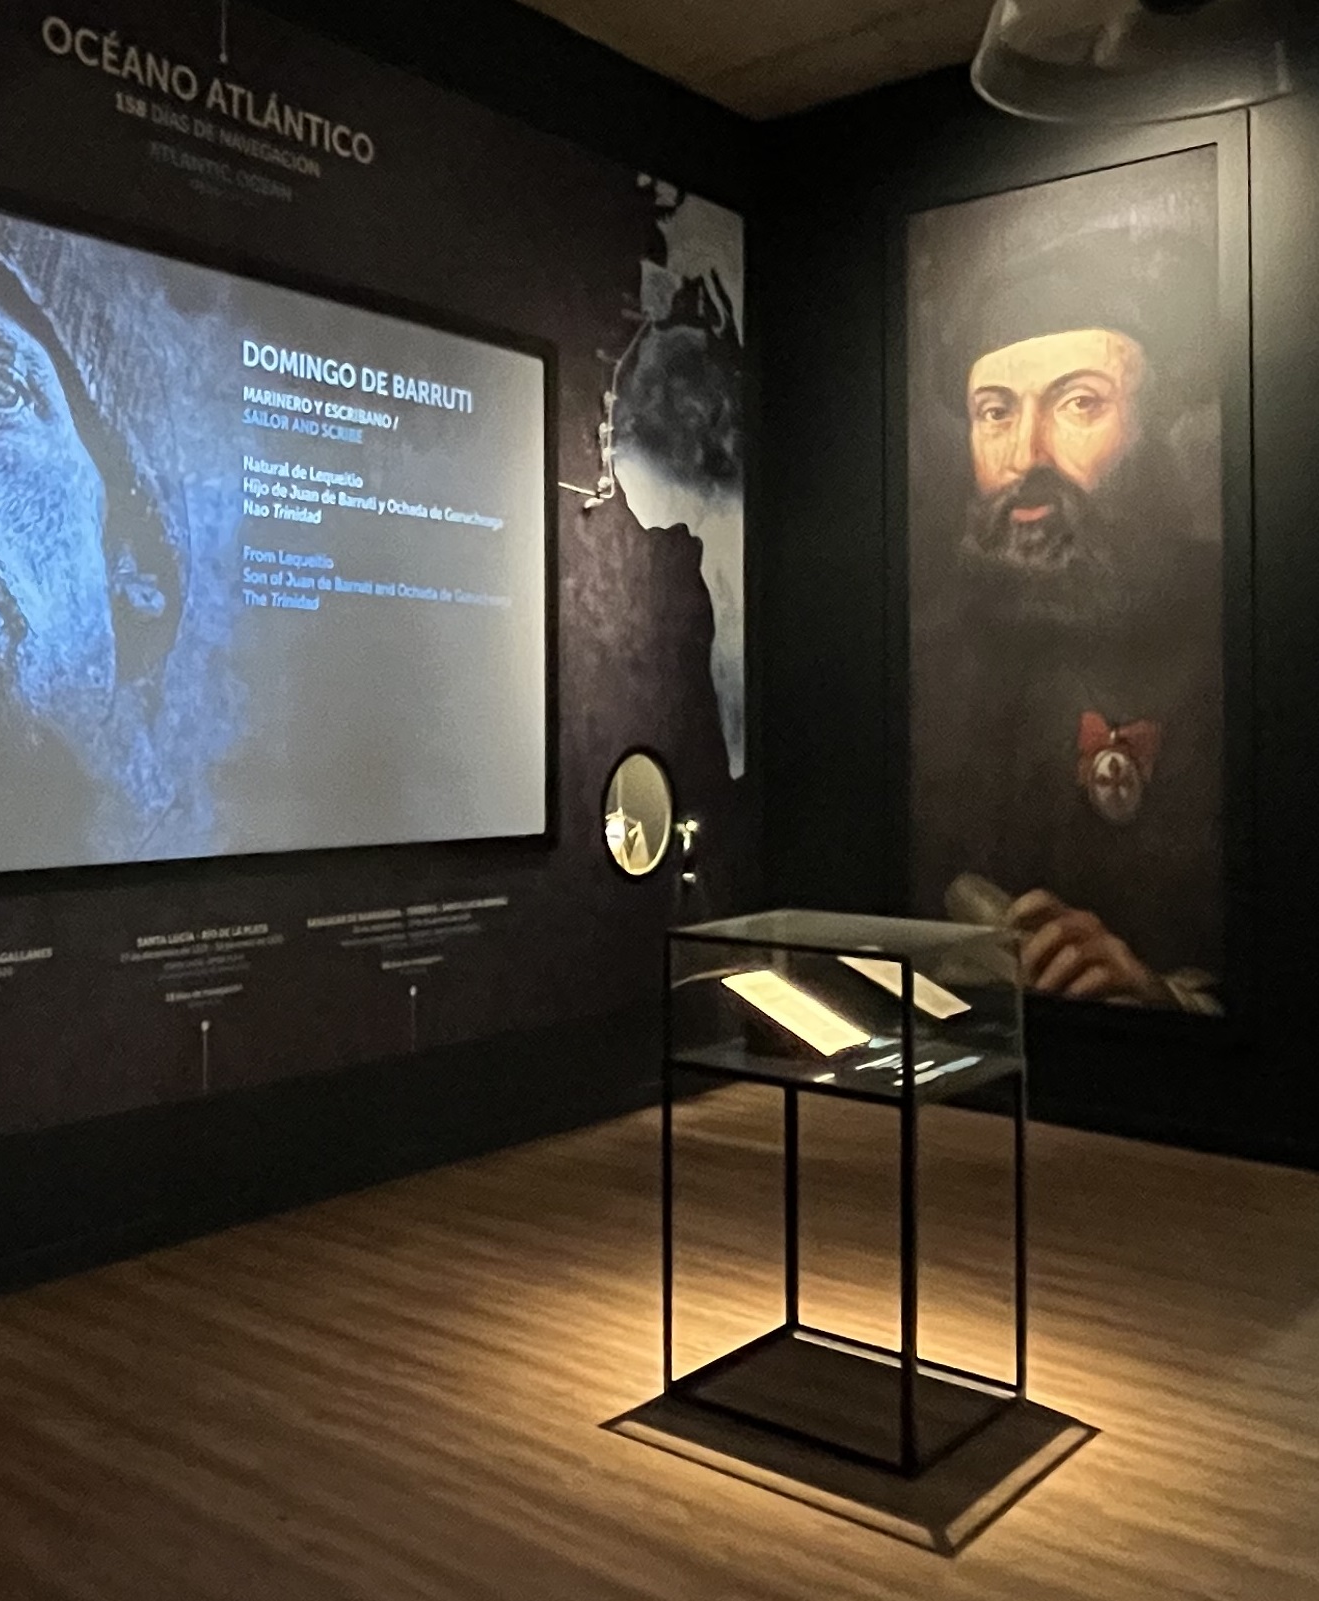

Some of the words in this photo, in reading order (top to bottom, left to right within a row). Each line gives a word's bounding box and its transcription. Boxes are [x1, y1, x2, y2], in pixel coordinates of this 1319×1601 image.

[42, 16, 198, 101] OCÉANO
[205, 77, 374, 164] ATLÁNTICO
[116, 91, 147, 118] 158
[193, 117, 215, 143] DE
[242, 340, 357, 389] DOMINGO
[361, 367, 388, 396] DE
[392, 374, 474, 414] BARRUTI
[243, 386, 312, 414] MARINERO
[314, 399, 323, 415] Y
[324, 402, 392, 429] ESCRIBANO
[242, 408, 289, 430] SAILOR
[292, 418, 320, 436] AND
[321, 424, 363, 444] SCRIBE
[243, 455, 290, 478] Natural
[291, 464, 308, 480] de
[243, 477, 269, 498] Hijo
[271, 482, 288, 499] de
[290, 484, 319, 503] Juan
[321, 488, 336, 505] de
[378, 500, 386, 515] y
[243, 498, 270, 518] Nao
[272, 503, 322, 524] Trinidad
[243, 545, 276, 563] From
[243, 567, 267, 583] Son
[269, 570, 283, 586] of
[285, 570, 315, 588] Juan
[317, 576, 332, 590] de
[242, 588, 267, 606] The
[271, 591, 320, 611] Trinidad
